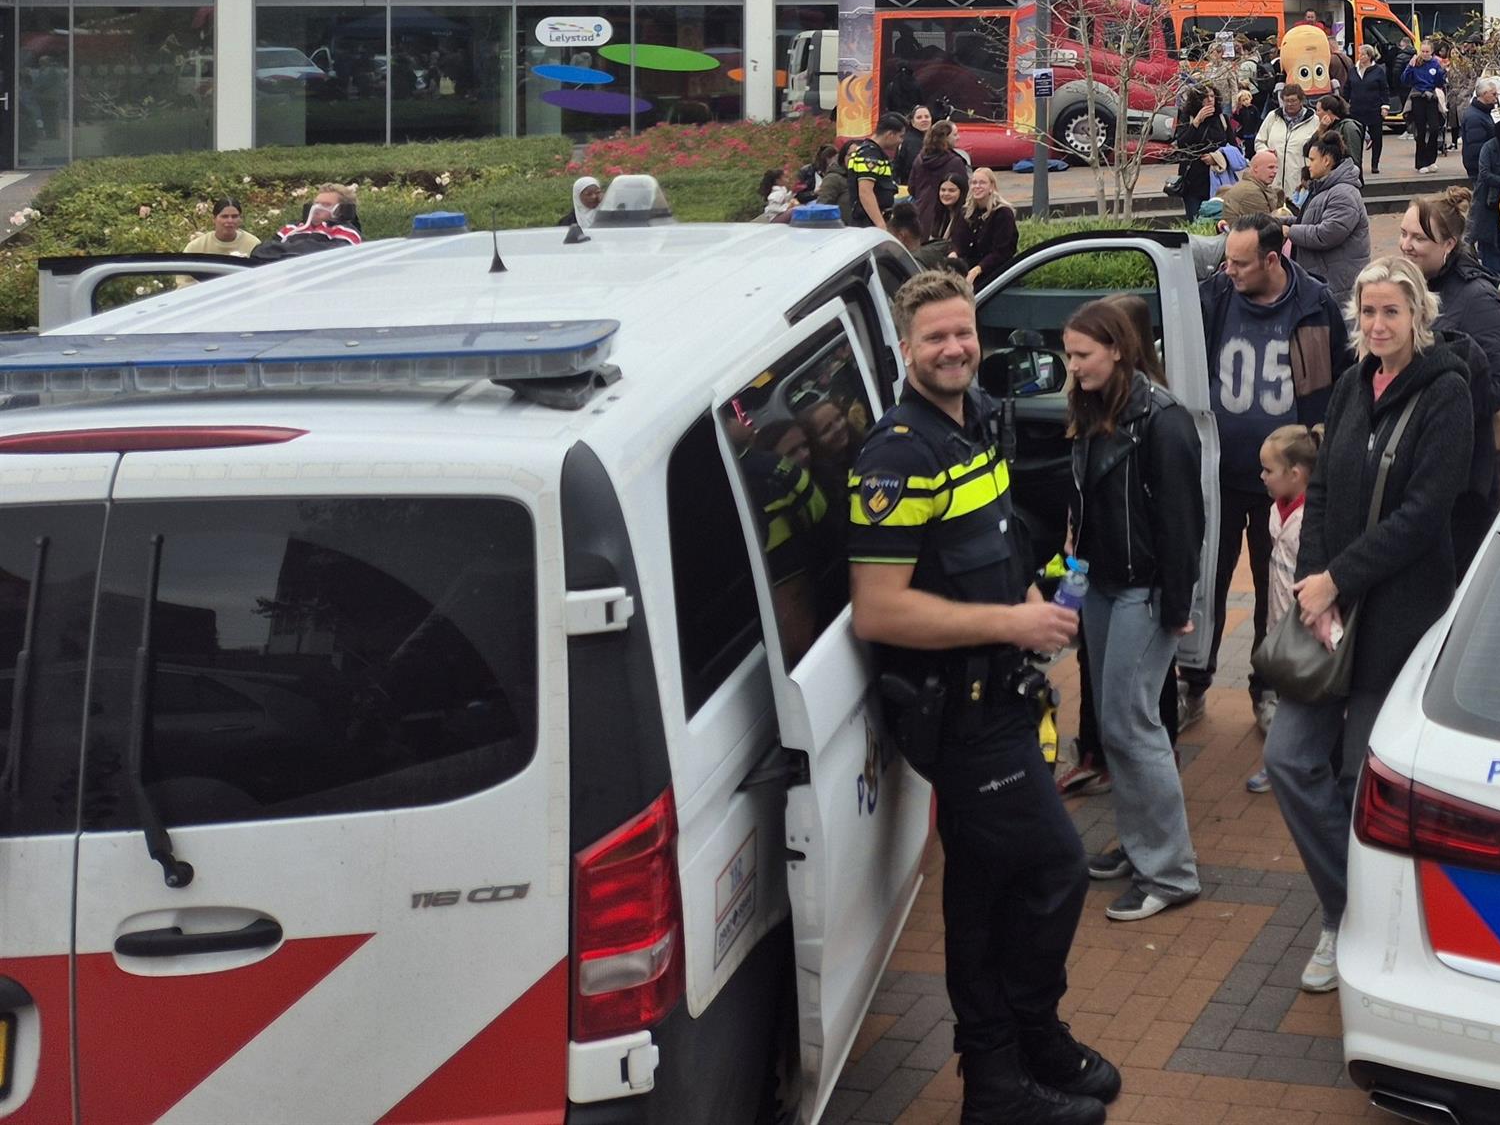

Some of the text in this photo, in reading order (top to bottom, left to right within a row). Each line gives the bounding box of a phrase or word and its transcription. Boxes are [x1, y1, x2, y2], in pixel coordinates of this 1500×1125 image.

[549, 33, 594, 43] Lelystad
[1219, 336, 1294, 416] 05
[411, 882, 530, 909] 116 CDI
